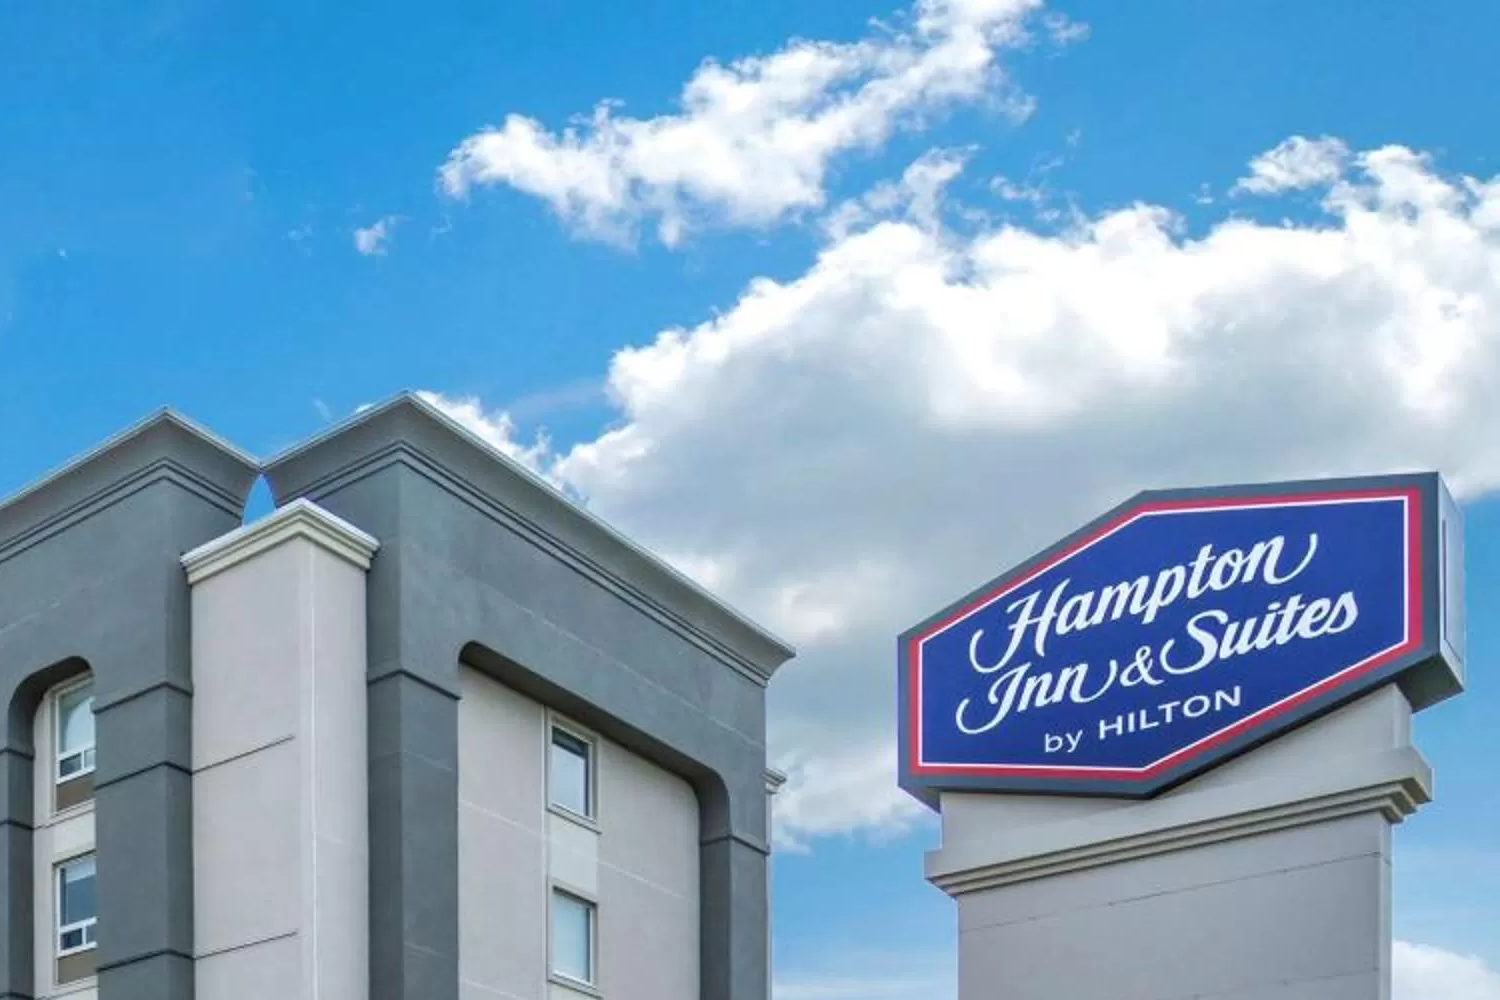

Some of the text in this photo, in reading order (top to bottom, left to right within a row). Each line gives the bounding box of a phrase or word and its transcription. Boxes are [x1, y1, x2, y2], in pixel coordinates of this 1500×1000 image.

[955, 590, 1360, 734] Inn & Suites
[969, 532, 1318, 674] Hampton
[1043, 684, 1243, 754] by HILTON
